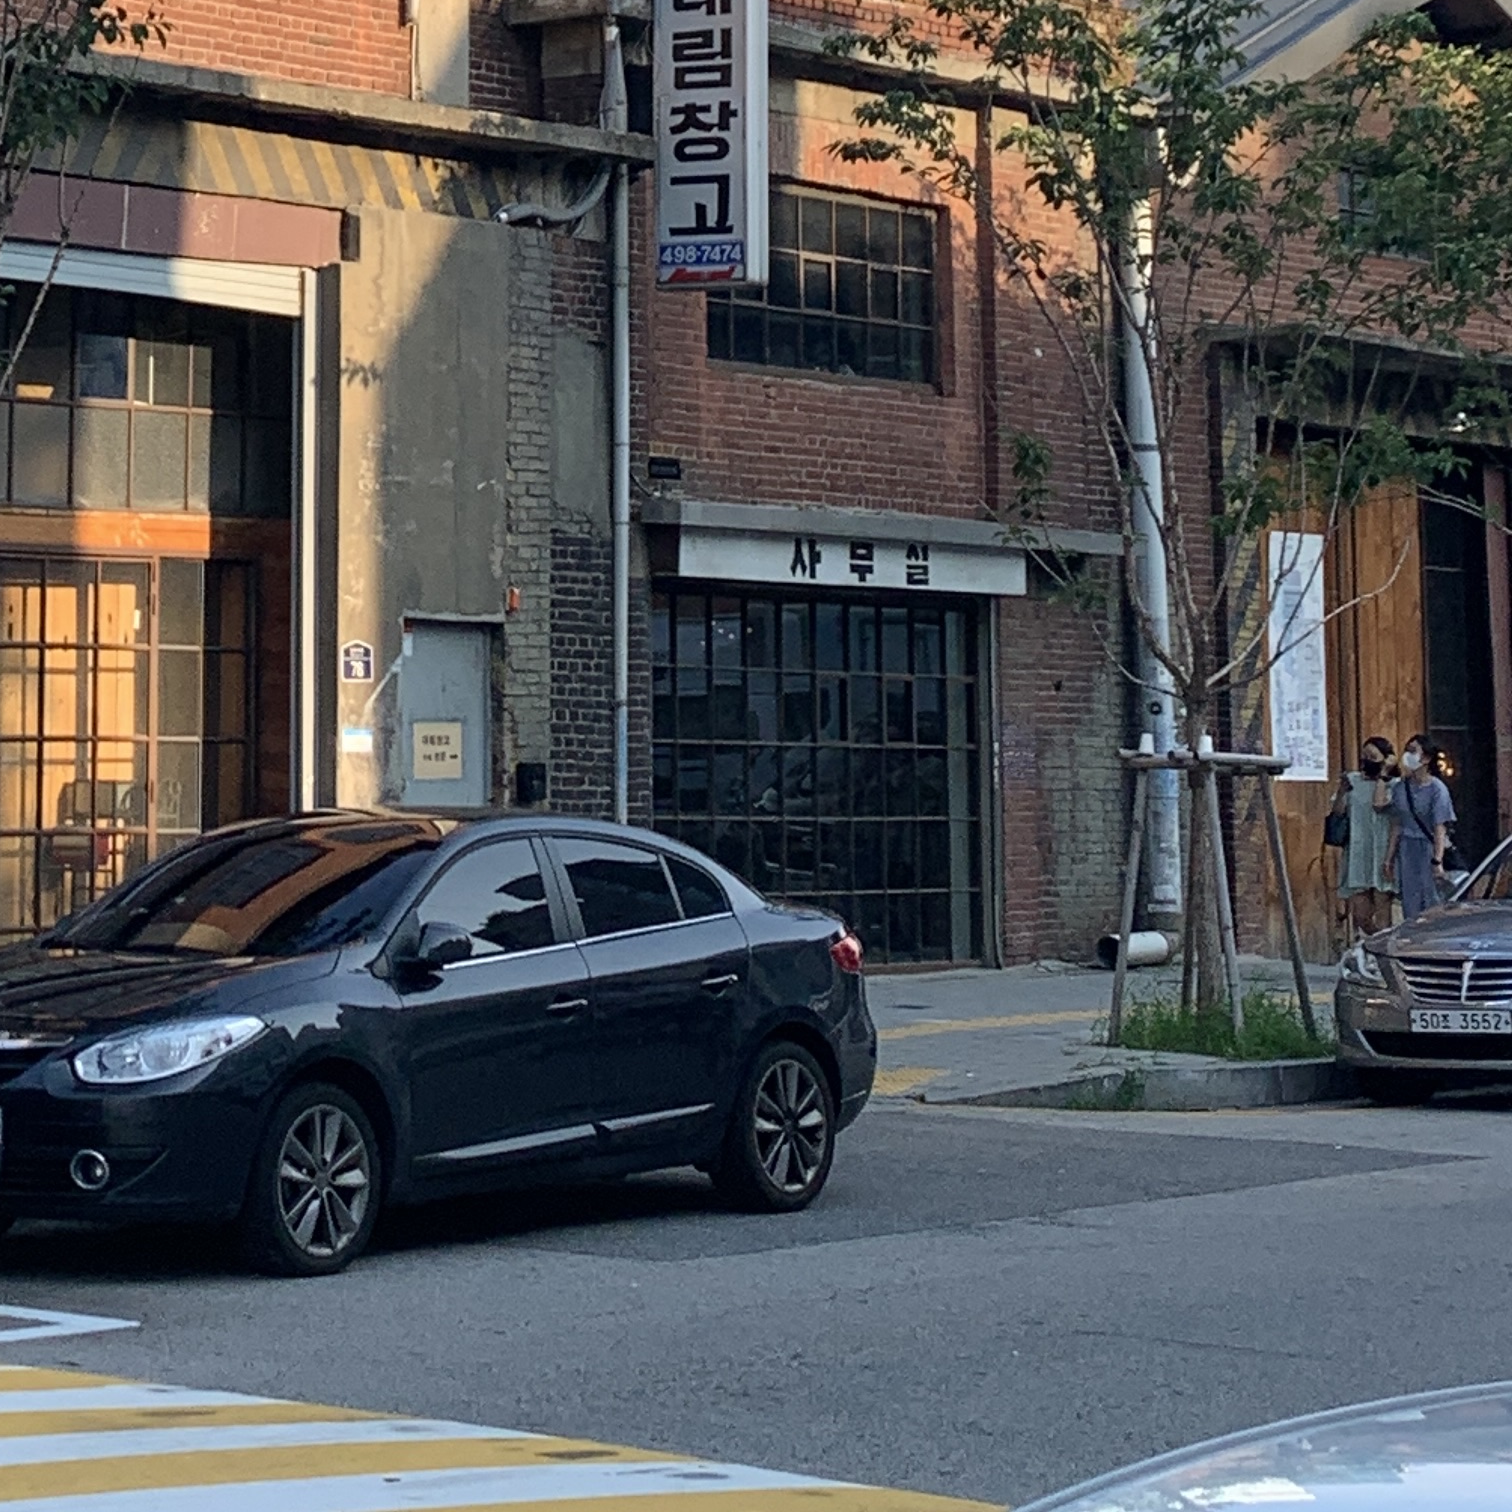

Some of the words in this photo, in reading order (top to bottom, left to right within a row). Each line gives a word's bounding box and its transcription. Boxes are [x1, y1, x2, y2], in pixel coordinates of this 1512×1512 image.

[661, 244, 742, 263] 498-7474
[790, 537, 930, 586] 사무실
[1459, 1013, 1502, 1030] 3552
